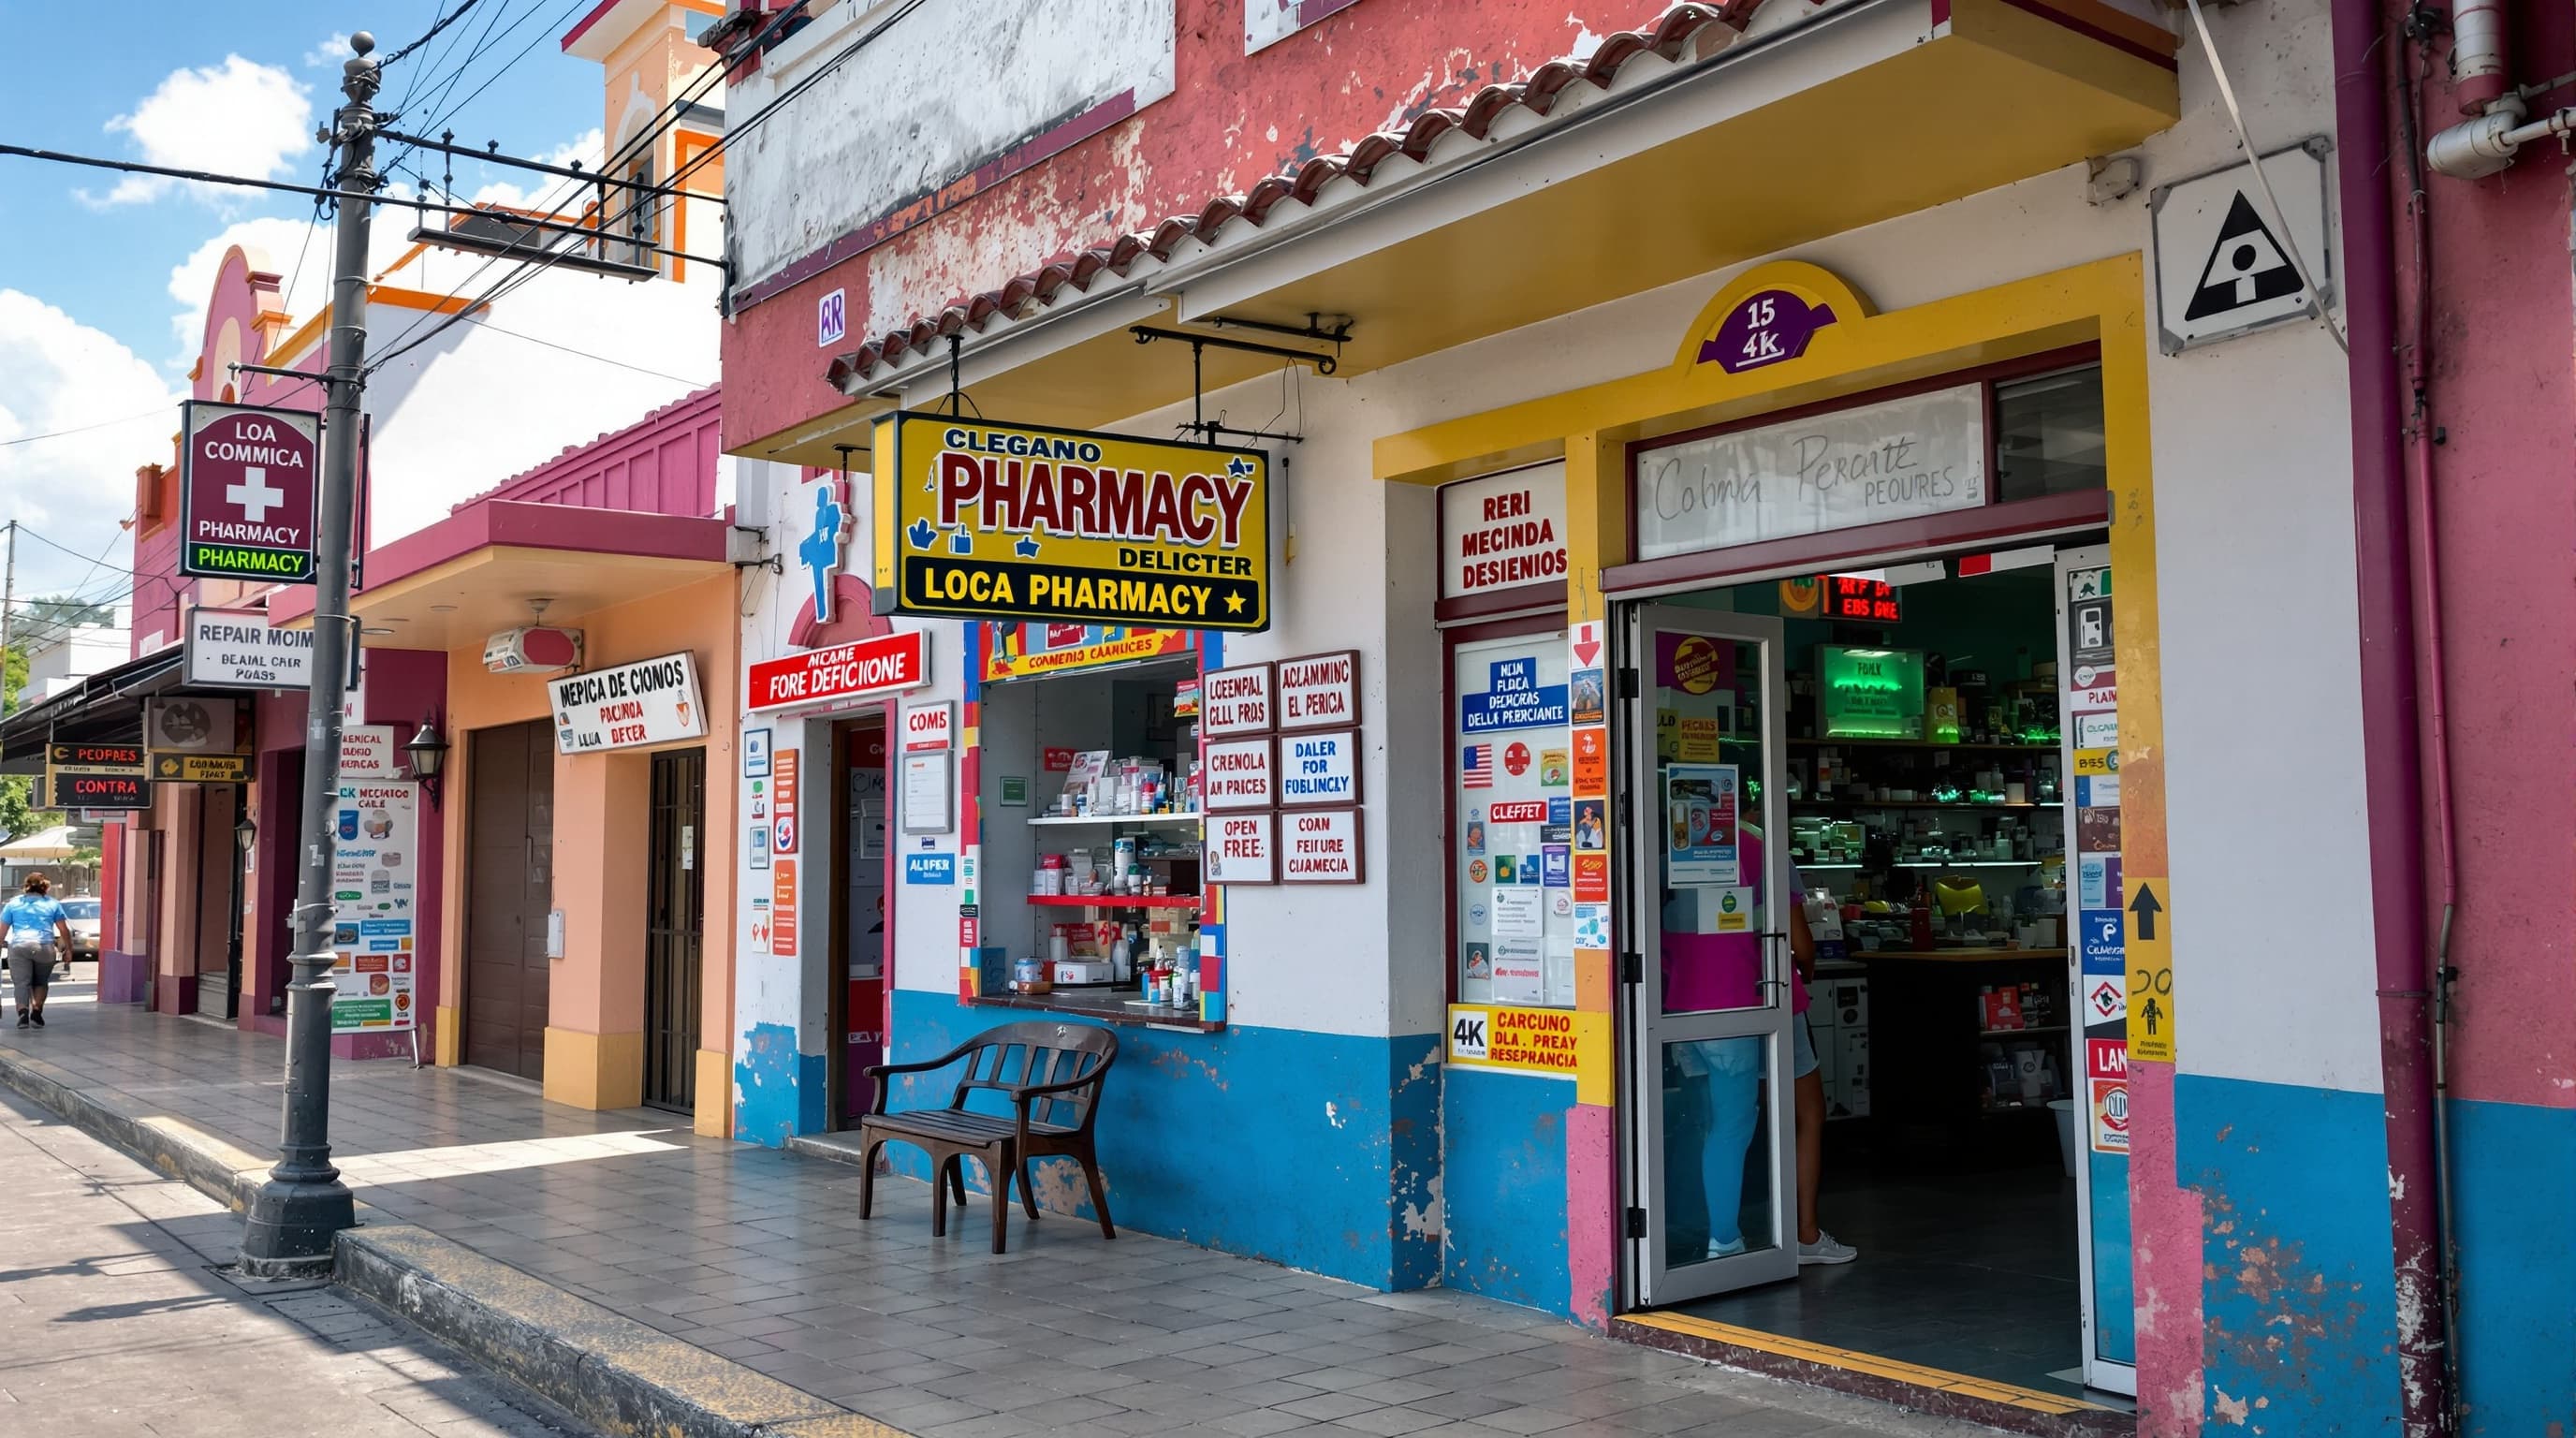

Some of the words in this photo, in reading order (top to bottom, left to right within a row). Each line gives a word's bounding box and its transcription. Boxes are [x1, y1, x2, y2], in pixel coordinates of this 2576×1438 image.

[1747, 298, 1776, 330] 15
[1742, 330, 1780, 360] 4K
[236, 421, 277, 443] LOA
[204, 441, 304, 468] COMMICA
[944, 428, 1102, 463] CLEGANO
[937, 449, 1254, 549] PHARMACY
[1483, 490, 1530, 522] RERI
[198, 520, 300, 545] PHARMACY
[1462, 519, 1554, 558] MECINDA
[198, 548, 304, 573] PHARMACY
[1118, 547, 1252, 577] DELICTER
[1462, 548, 1568, 590] DESIENIOS
[924, 567, 1015, 604] LOCA
[1030, 578, 1212, 615] PHARMACY
[199, 624, 261, 645] REPAIR
[560, 677, 607, 709] MEPICA
[608, 671, 628, 698] DE
[769, 670, 808, 700] FORE
[1288, 696, 1301, 718] EL
[1211, 752, 1266, 772] CRENOLA
[1295, 741, 1337, 757] DALER
[1302, 759, 1327, 775] FOR
[75, 780, 138, 795] CONTRA
[1226, 778, 1266, 796] PRICES
[1224, 819, 1257, 836] OPEN
[1454, 1018, 1485, 1047] 4K
[1497, 1011, 1571, 1033] CARCUNO
[1495, 1032, 1519, 1047] DLA
[1533, 1034, 1578, 1050] PREAY
